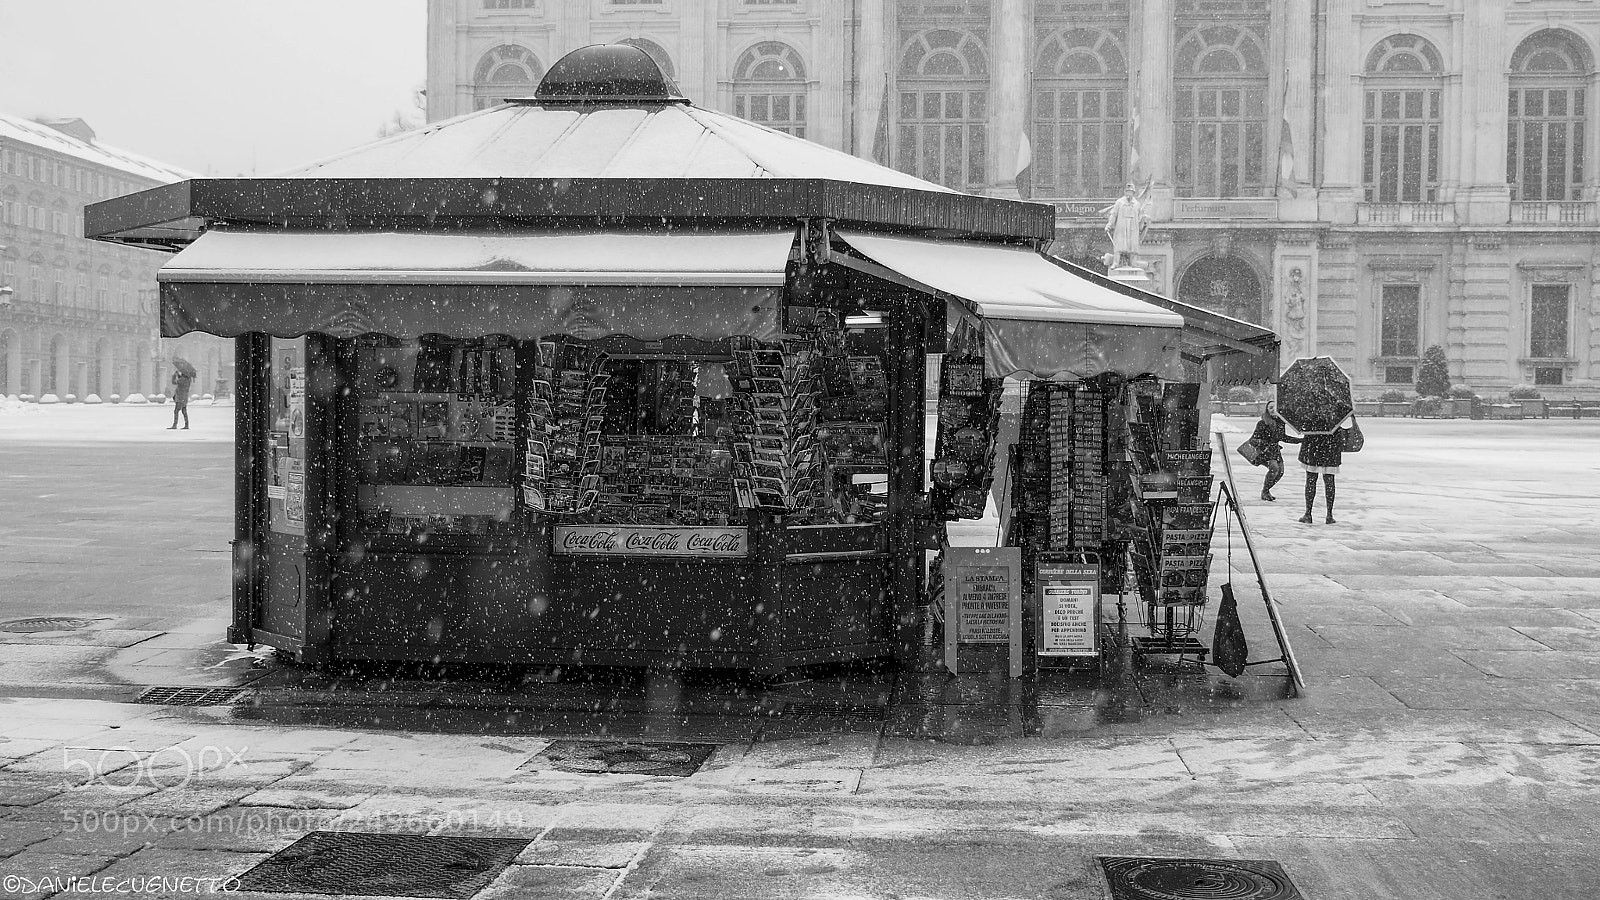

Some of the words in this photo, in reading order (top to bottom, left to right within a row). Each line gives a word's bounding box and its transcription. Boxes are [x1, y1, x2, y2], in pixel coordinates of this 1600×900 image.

[1065, 203, 1095, 216] Magno
[1177, 479, 1208, 487] HELANGELO
[1180, 506, 1209, 514] FRANCESCO
[985, 601, 1009, 610] INVESTIRE
